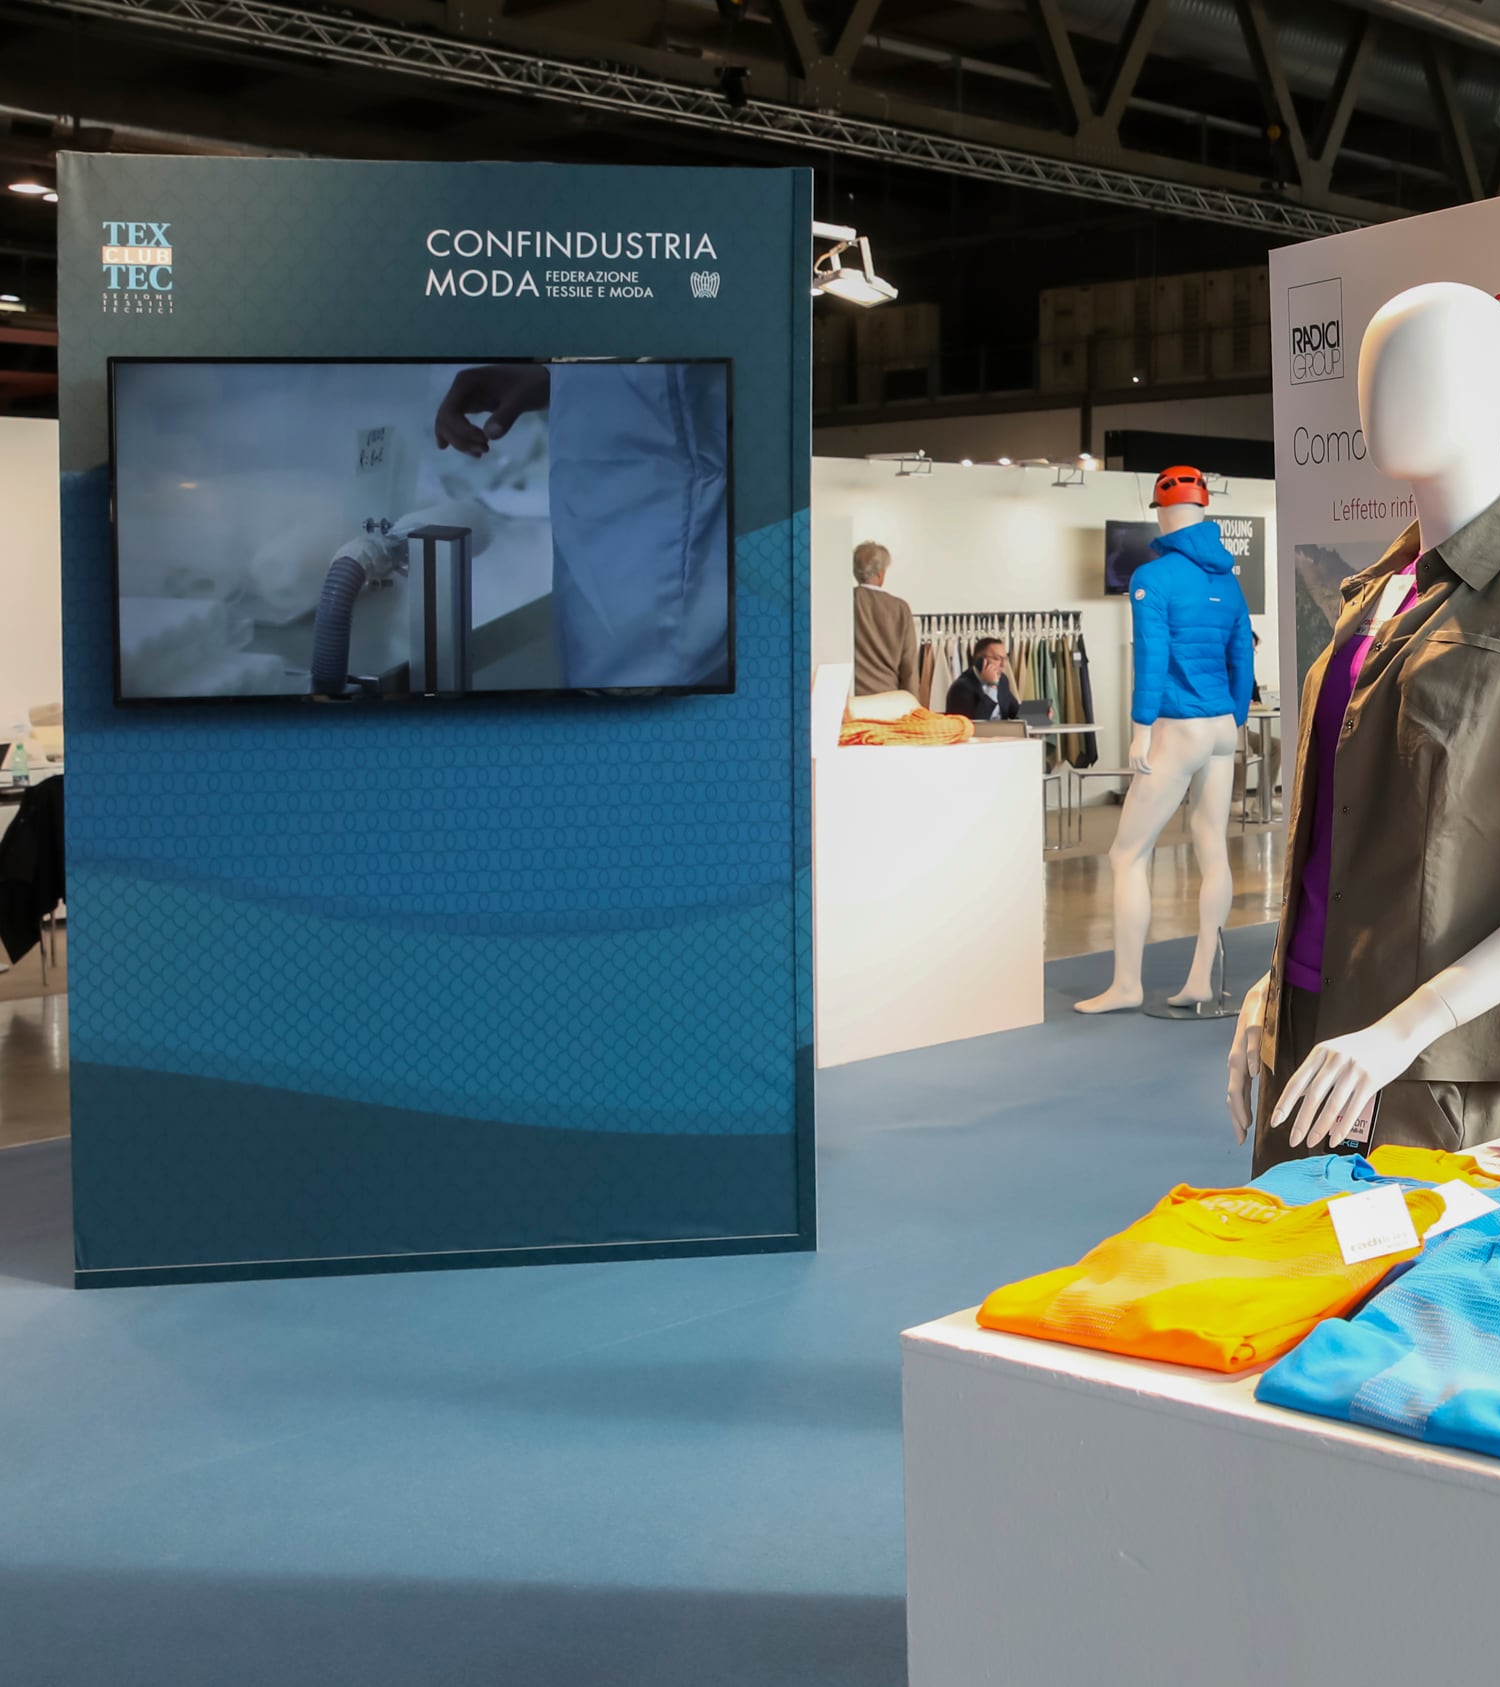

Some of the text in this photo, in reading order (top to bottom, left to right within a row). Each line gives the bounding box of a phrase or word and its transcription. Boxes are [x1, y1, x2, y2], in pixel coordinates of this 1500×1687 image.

[102, 221, 172, 247] TEX
[426, 229, 717, 259] CONFINDUSTRIA
[105, 248, 169, 263] CLUB
[102, 264, 173, 291] TEC
[425, 269, 540, 297] MODA
[545, 271, 639, 283] FEDERAZIONE
[545, 286, 654, 298] TESSILE E MODA
[1292, 320, 1340, 355] RADICI
[1293, 349, 1341, 379] GROUP
[1294, 426, 1367, 466] Como
[1333, 497, 1387, 521] L'effetto
[1213, 519, 1253, 537] YOSUNG
[1220, 538, 1250, 556] UROPE
